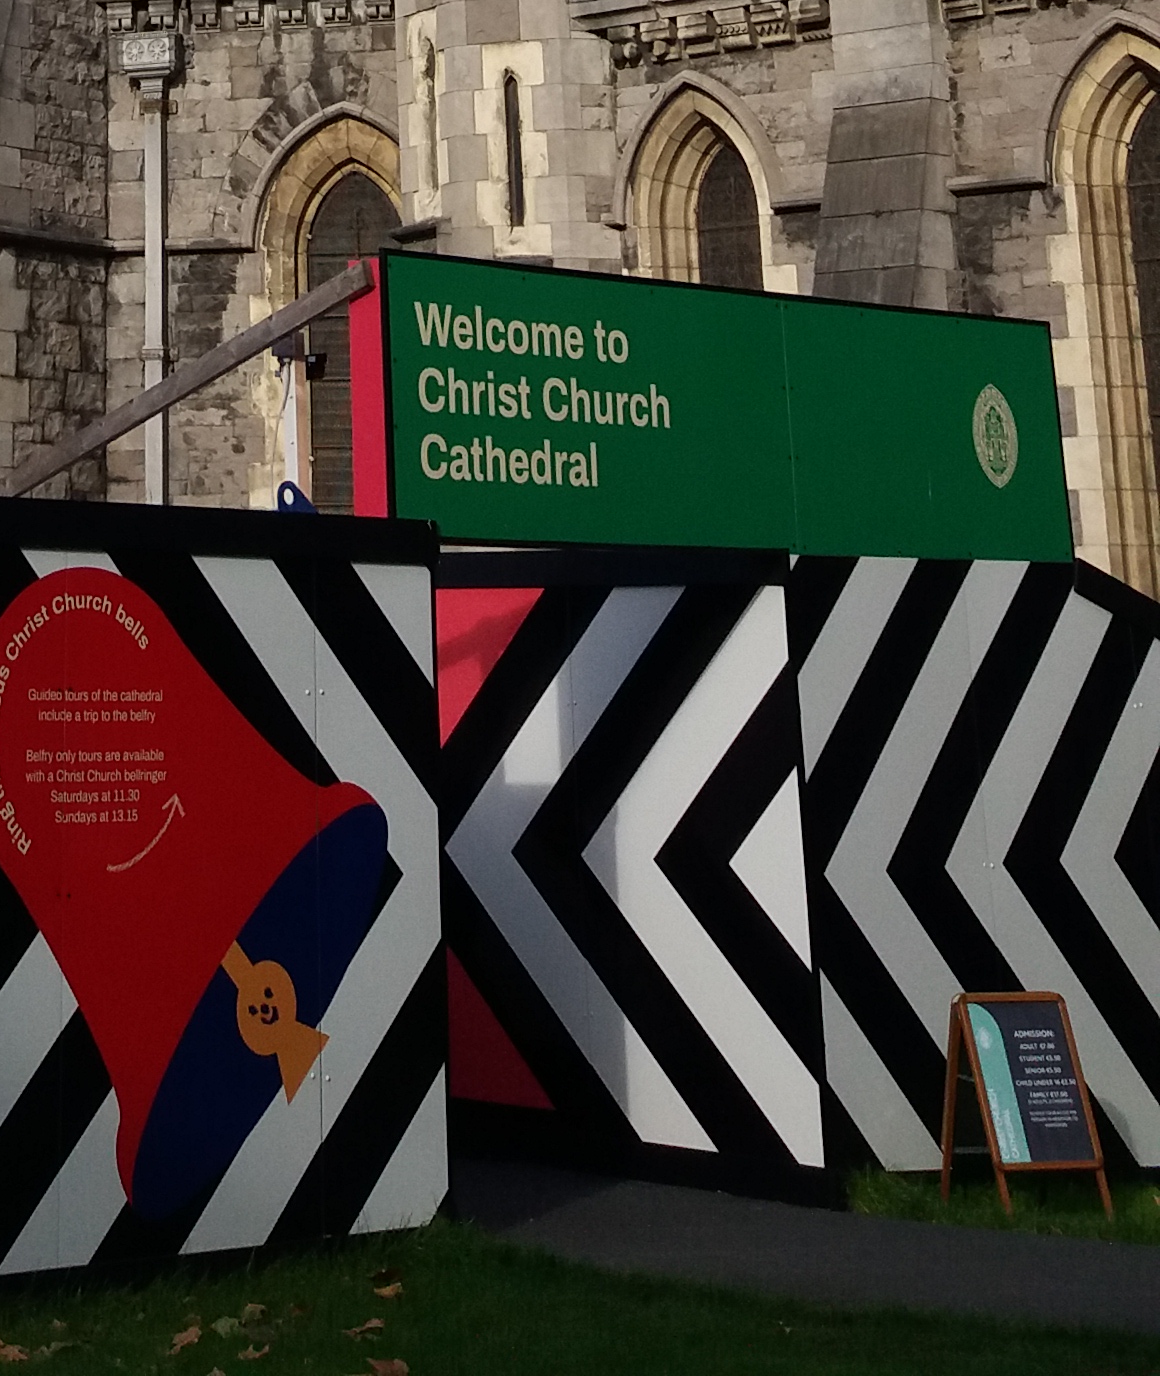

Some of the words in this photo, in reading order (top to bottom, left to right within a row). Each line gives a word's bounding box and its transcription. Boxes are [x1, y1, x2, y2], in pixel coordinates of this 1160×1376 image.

[414, 301, 584, 360] Welcome
[593, 320, 629, 363] to
[418, 367, 532, 419] Christ
[542, 377, 671, 429] Church
[420, 433, 598, 487] Cathedral
[5, 605, 50, 661] Christ
[52, 592, 112, 615] Church
[115, 603, 149, 650] bells
[28, 688, 62, 701] Guided
[65, 689, 88, 702] tours
[91, 689, 100, 701] of
[103, 689, 118, 702] the
[120, 689, 163, 702] cathedral
[39, 709, 72, 721] include
[75, 712, 81, 721] a
[84, 710, 98, 723] trip
[101, 710, 110, 721] to
[113, 709, 127, 721] the
[130, 709, 155, 723] belfry
[26, 749, 53, 764] Belfry
[56, 750, 76, 764] only
[79, 750, 102, 761] tours
[105, 751, 120, 761] are
[123, 749, 164, 761] available
[25, 769, 45, 782] with
[47, 772, 54, 782] a
[56, 769, 84, 782] Christ
[87, 769, 121, 782] Church
[124, 769, 166, 784] bellringer
[51, 789, 99, 805] Saturdays
[101, 790, 111, 802] at
[113, 789, 140, 802] 11.30
[55, 810, 97, 825] Sundays
[100, 810, 109, 823] at
[112, 809, 138, 822] 13.15
[1014, 1029, 1055, 1038] ADMISSION:
